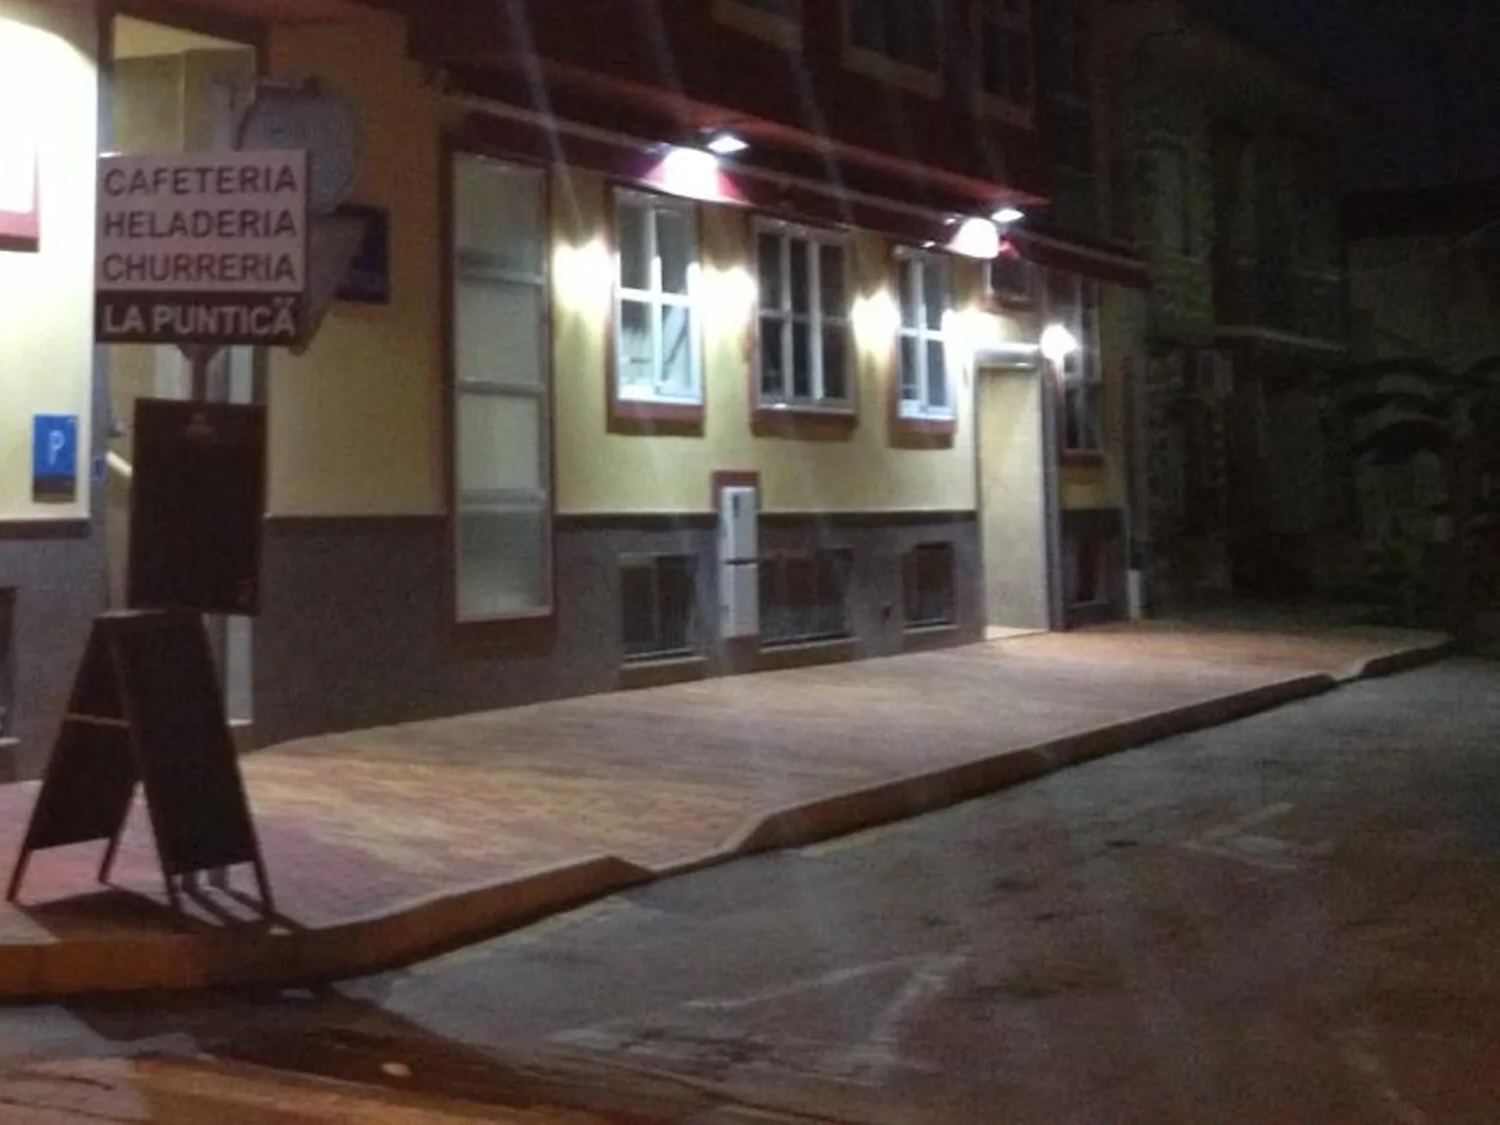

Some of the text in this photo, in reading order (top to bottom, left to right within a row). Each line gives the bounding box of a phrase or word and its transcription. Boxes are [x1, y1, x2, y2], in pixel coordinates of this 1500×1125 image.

[102, 164, 299, 197] CAFETERIA
[102, 208, 297, 239] HELADERIA
[101, 251, 297, 283] CHURRERIA
[103, 304, 297, 336] LA PUNTICA
